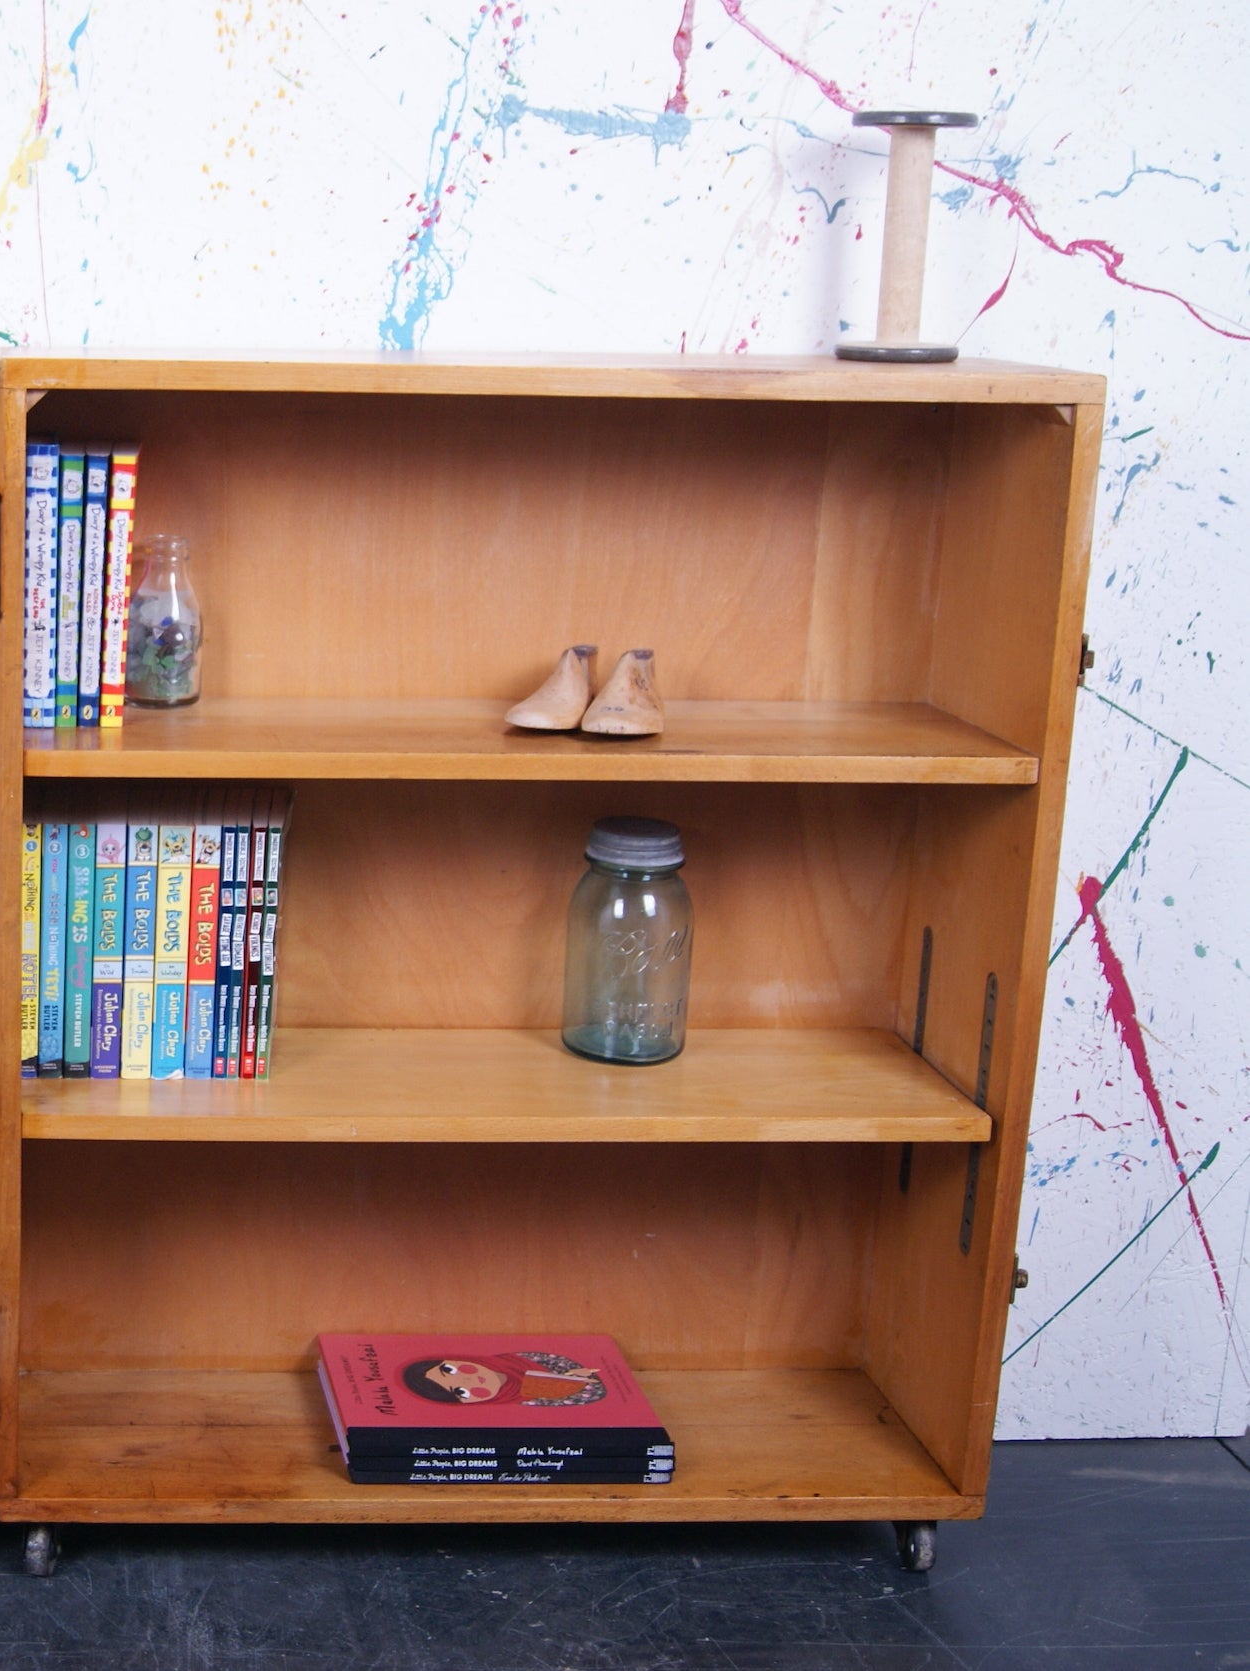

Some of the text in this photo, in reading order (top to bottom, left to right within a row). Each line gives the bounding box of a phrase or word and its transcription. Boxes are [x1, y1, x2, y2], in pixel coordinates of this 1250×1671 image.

[36, 500, 48, 526] Diary
[34, 543, 46, 571] Wimpy
[89, 508, 101, 586] Diary Wimpy Kid
[36, 573, 46, 587] Kid
[34, 634, 44, 694] JEFF KINNEY
[52, 844, 57, 852] 2
[78, 848, 86, 856] 3
[23, 873, 38, 912] NOTHING
[72, 866, 90, 924] SEA-ING
[102, 872, 118, 903] THE
[132, 870, 152, 951] THE BOLDS
[163, 871, 183, 953] THE BOLDS
[194, 882, 215, 966] THE BOLDS
[72, 925, 89, 943] IS
[100, 909, 118, 951] BOLDS
[48, 927, 59, 966] NOTHING
[604, 924, 689, 978] Ball
[22, 954, 38, 1002] HOTEL
[43, 1004, 51, 1031] BUTLER
[104, 992, 119, 1024] Julian
[137, 991, 150, 1021] Julian
[198, 998, 212, 1028] Julian
[74, 1021, 82, 1047] BUTLER
[101, 1025, 117, 1051] Clary
[134, 1023, 149, 1049] Clary
[166, 991, 181, 1057] Julian Clary
[196, 1028, 212, 1054] Clary
[372, 1386, 399, 1416] Malala
[517, 1446, 545, 1456] Malala
